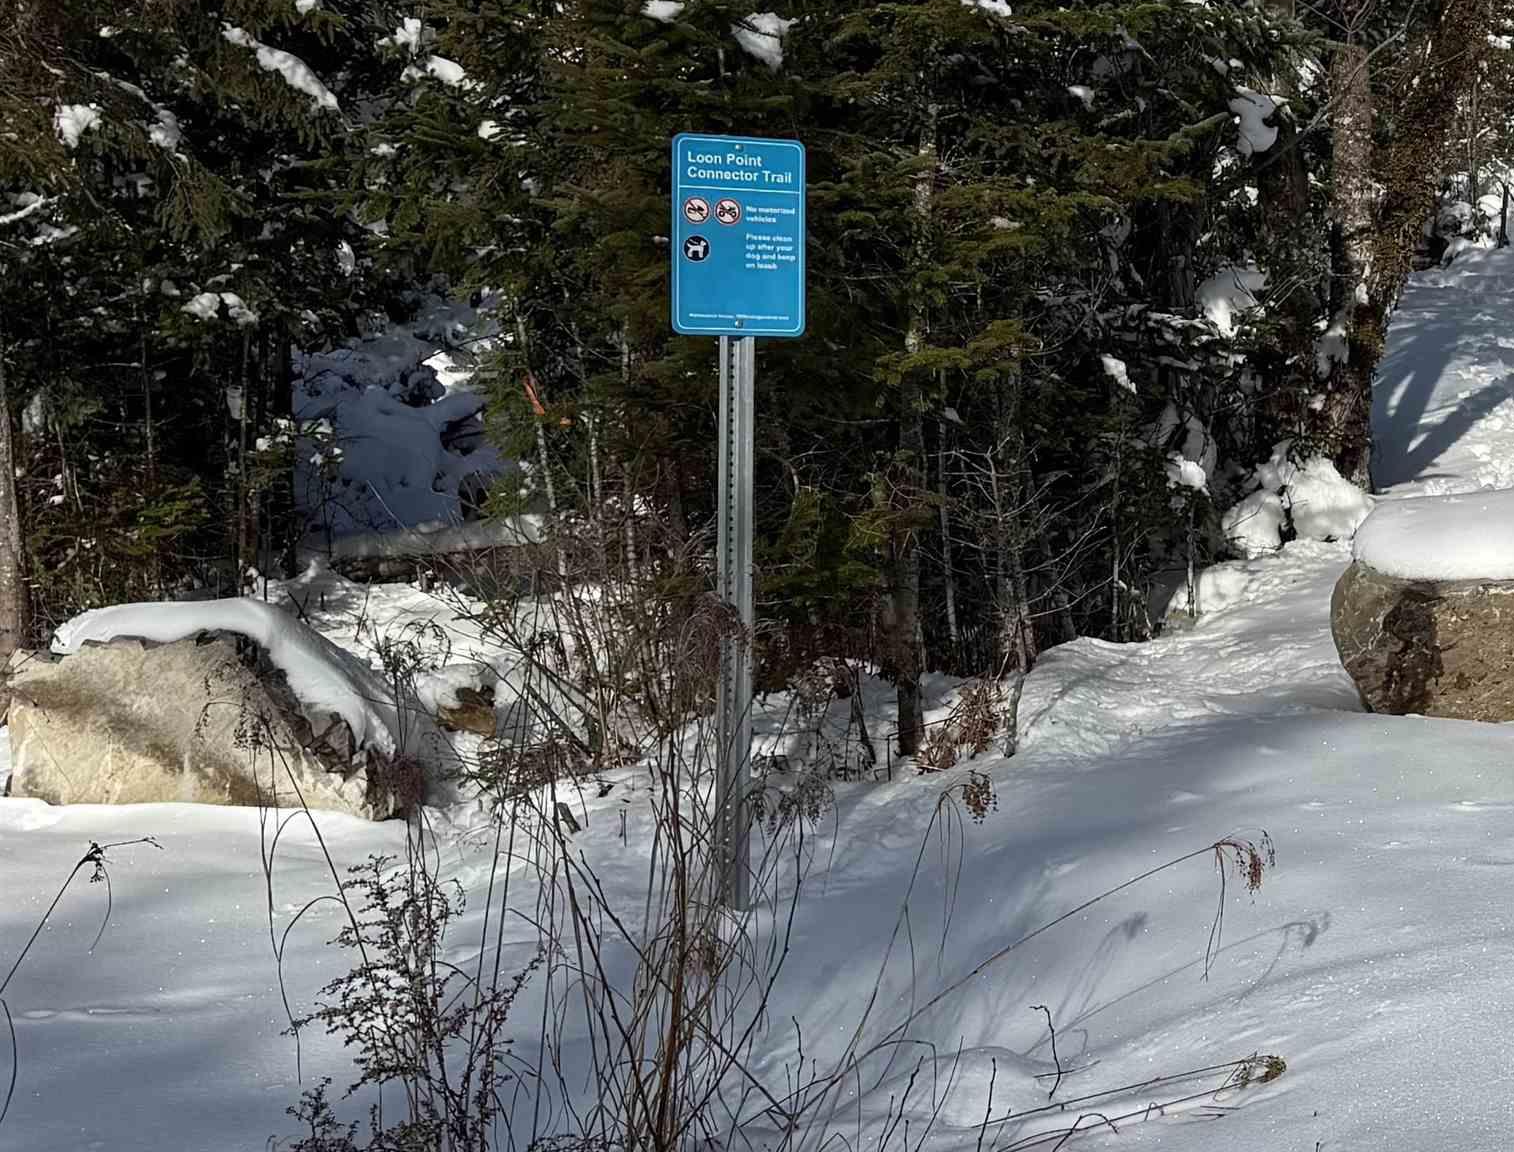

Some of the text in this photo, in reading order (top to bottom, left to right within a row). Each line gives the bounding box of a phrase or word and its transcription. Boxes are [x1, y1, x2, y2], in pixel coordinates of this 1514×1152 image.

[687, 151, 762, 167] Loon Point
[687, 166, 792, 184] Connector Trail
[746, 233, 771, 241] Please
